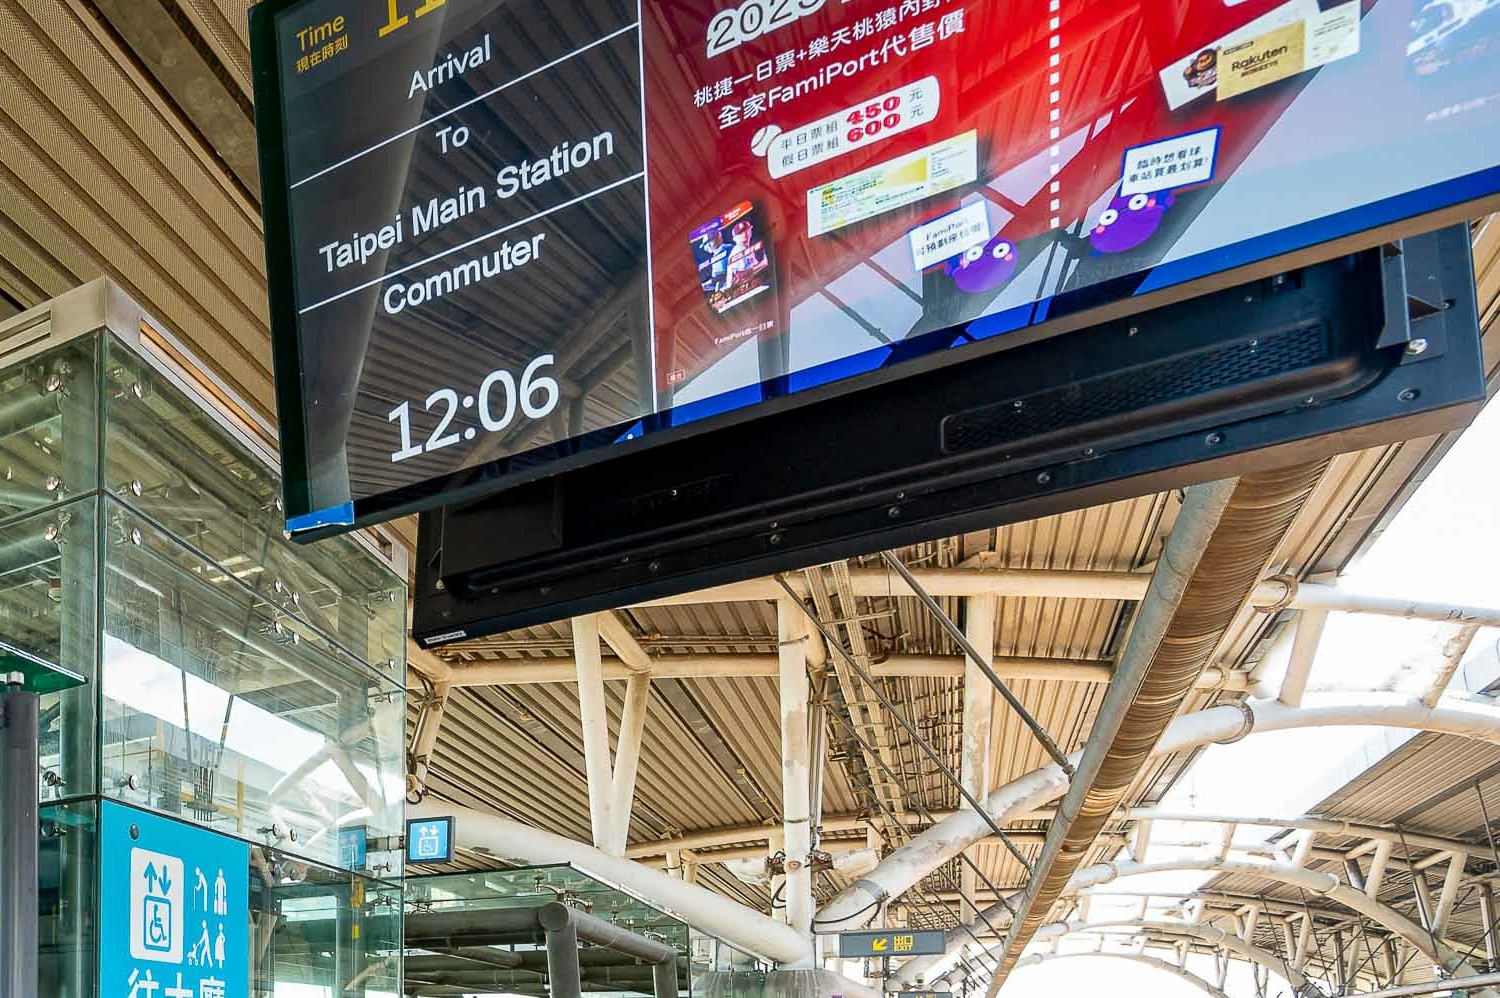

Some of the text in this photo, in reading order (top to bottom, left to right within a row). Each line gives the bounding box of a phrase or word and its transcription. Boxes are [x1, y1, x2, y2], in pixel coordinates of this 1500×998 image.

[296, 15, 345, 51] Time
[295, 34, 348, 73] 現在時刻
[408, 33, 491, 99] Arrival
[718, 8, 965, 130] 全家FamiPort代售價
[1231, 45, 1288, 72] Rakuten
[846, 96, 901, 125] 450
[909, 88, 925, 102] 元
[846, 113, 901, 143] 600
[909, 105, 925, 120] 元
[436, 126, 469, 156] To
[320, 129, 614, 274] Taipei Main Station
[384, 231, 546, 314] Commuter
[388, 353, 559, 463] 12:06
